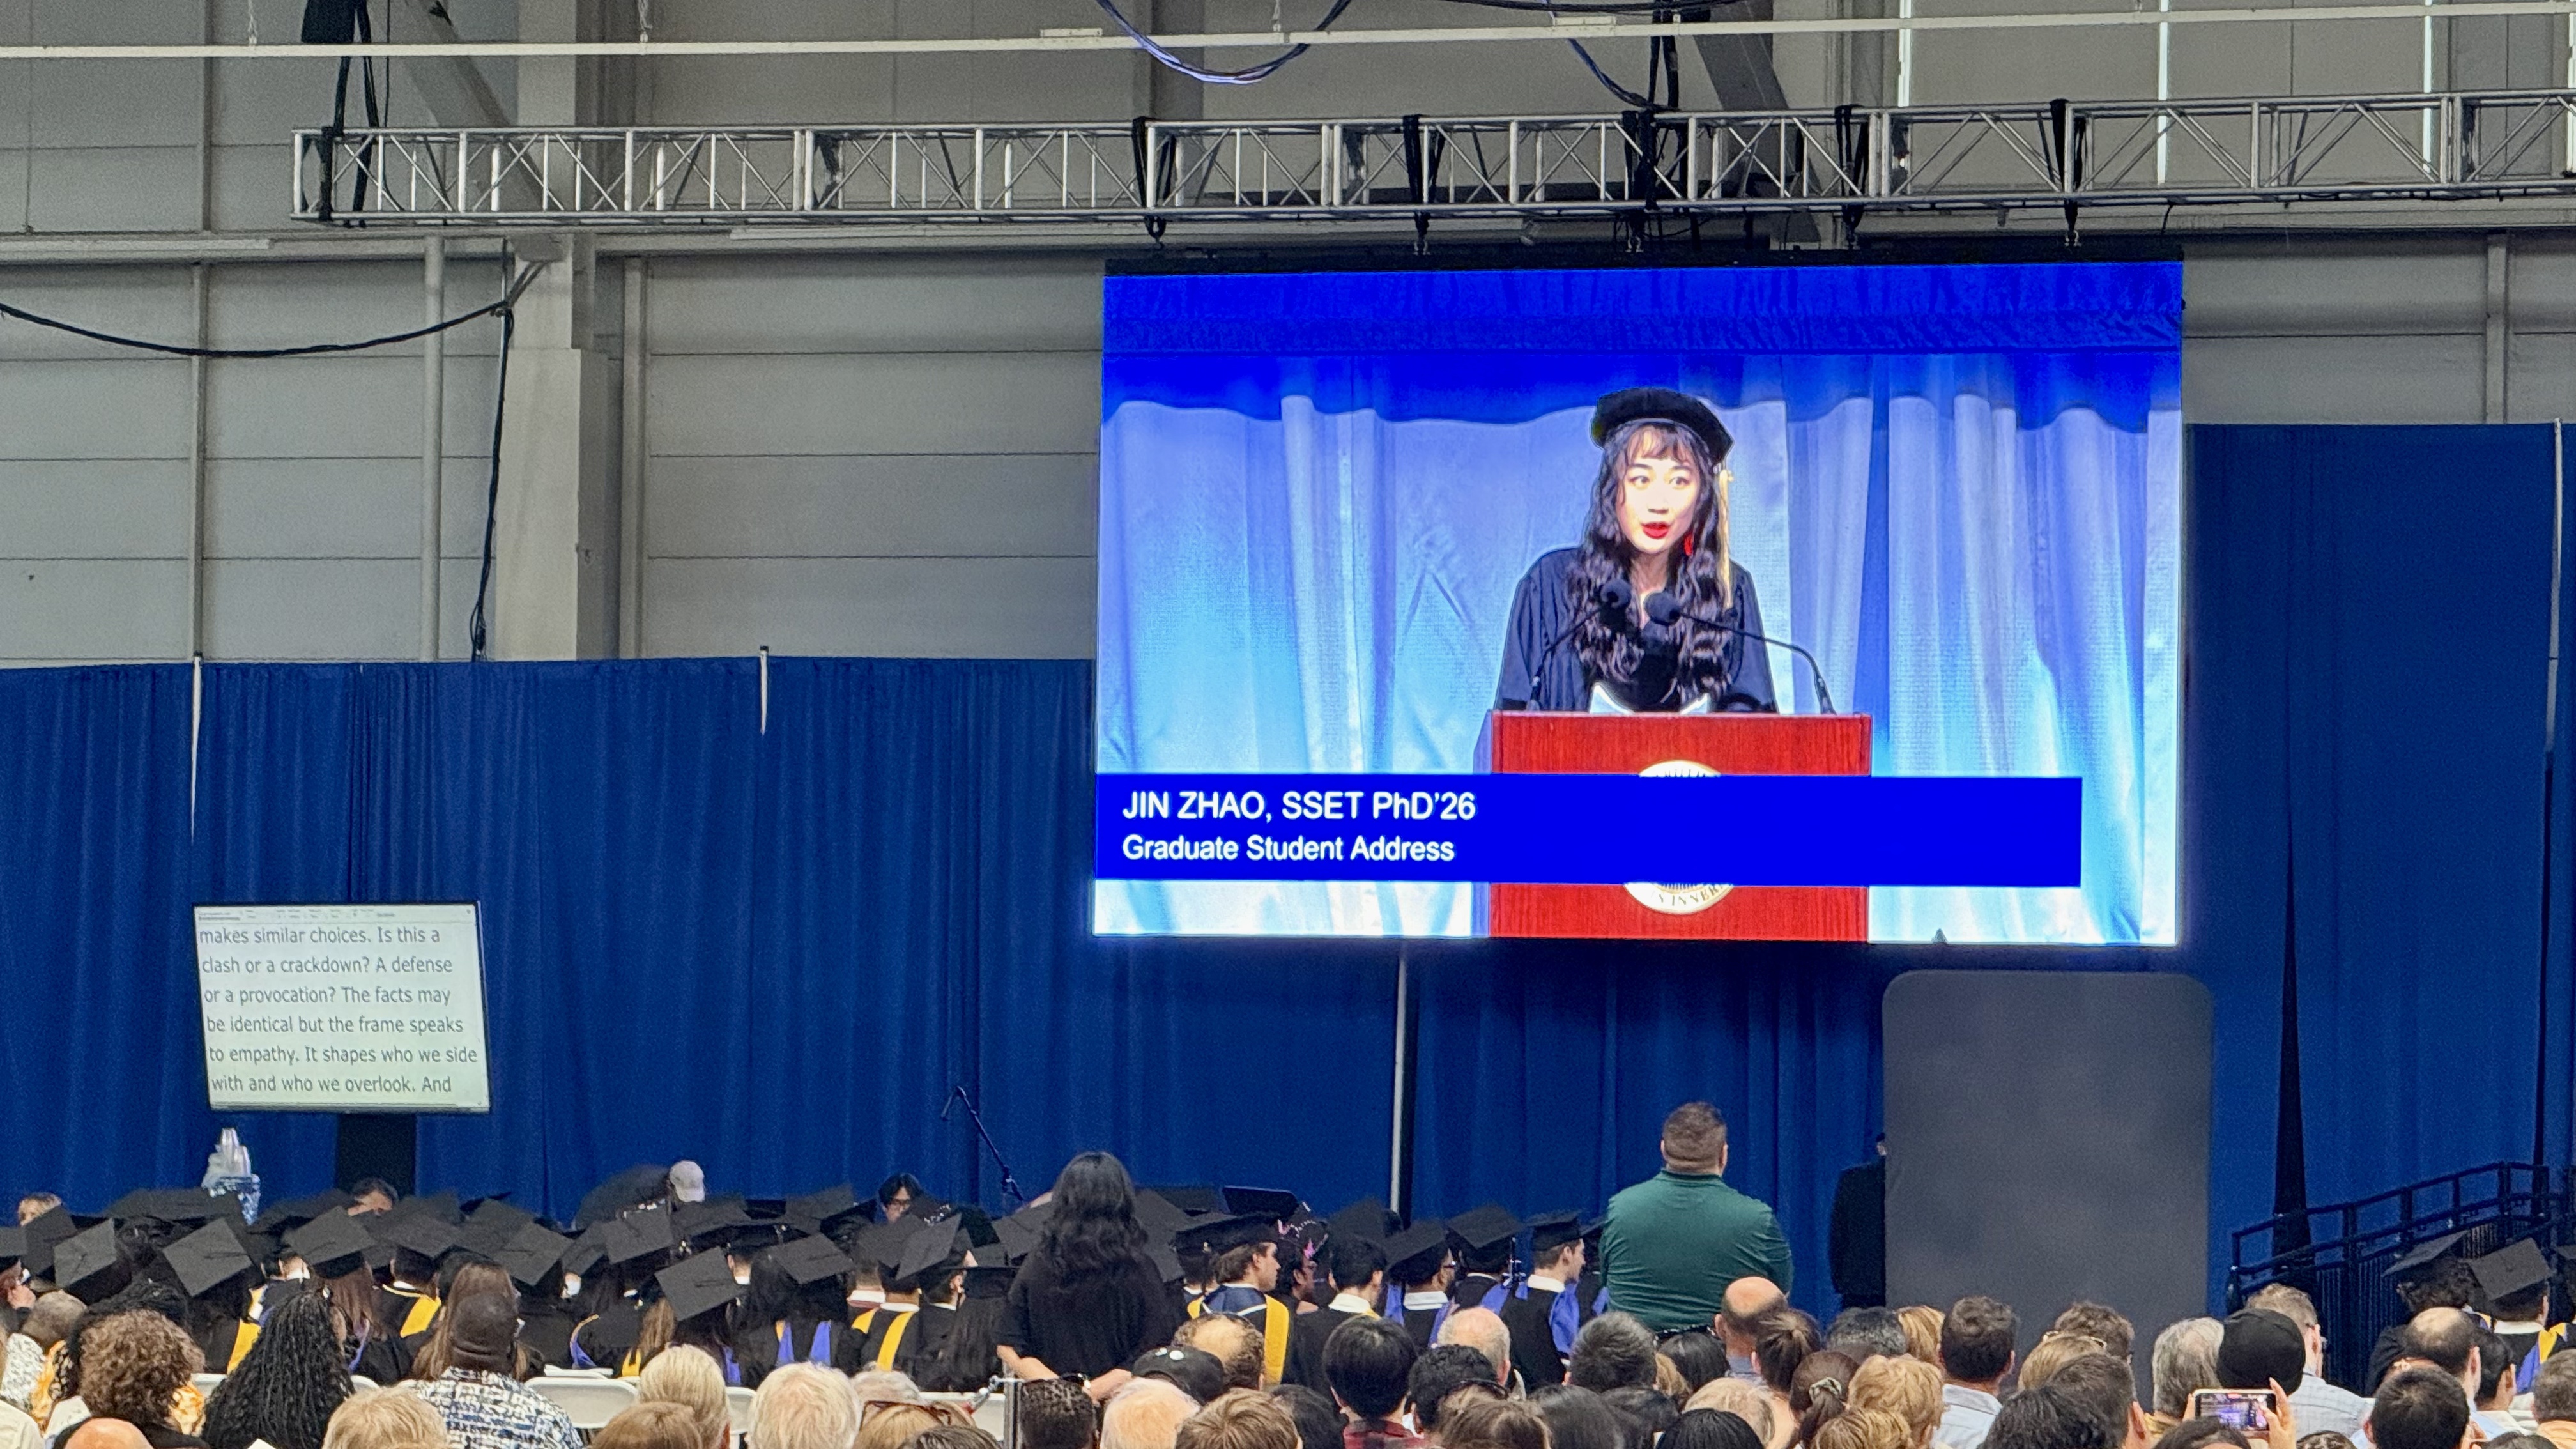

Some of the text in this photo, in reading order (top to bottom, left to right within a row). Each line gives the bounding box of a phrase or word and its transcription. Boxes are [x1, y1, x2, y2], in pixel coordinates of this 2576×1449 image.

[1123, 790, 1169, 820] JIN
[1177, 790, 1272, 823] ZHAO,
[1282, 790, 1365, 820] SSET
[1123, 833, 1455, 862] Graduate Student Address
[199, 925, 440, 944] makes similar choices. Is this a
[202, 954, 453, 974] clash or a crackdown? A defense
[204, 985, 451, 1007] or a provocation? The facts may
[206, 1014, 464, 1037] be identical but the frame speaks
[209, 1045, 478, 1066] to empathy. It shapes who we side
[211, 1073, 452, 1093] with and who we overlook. And
